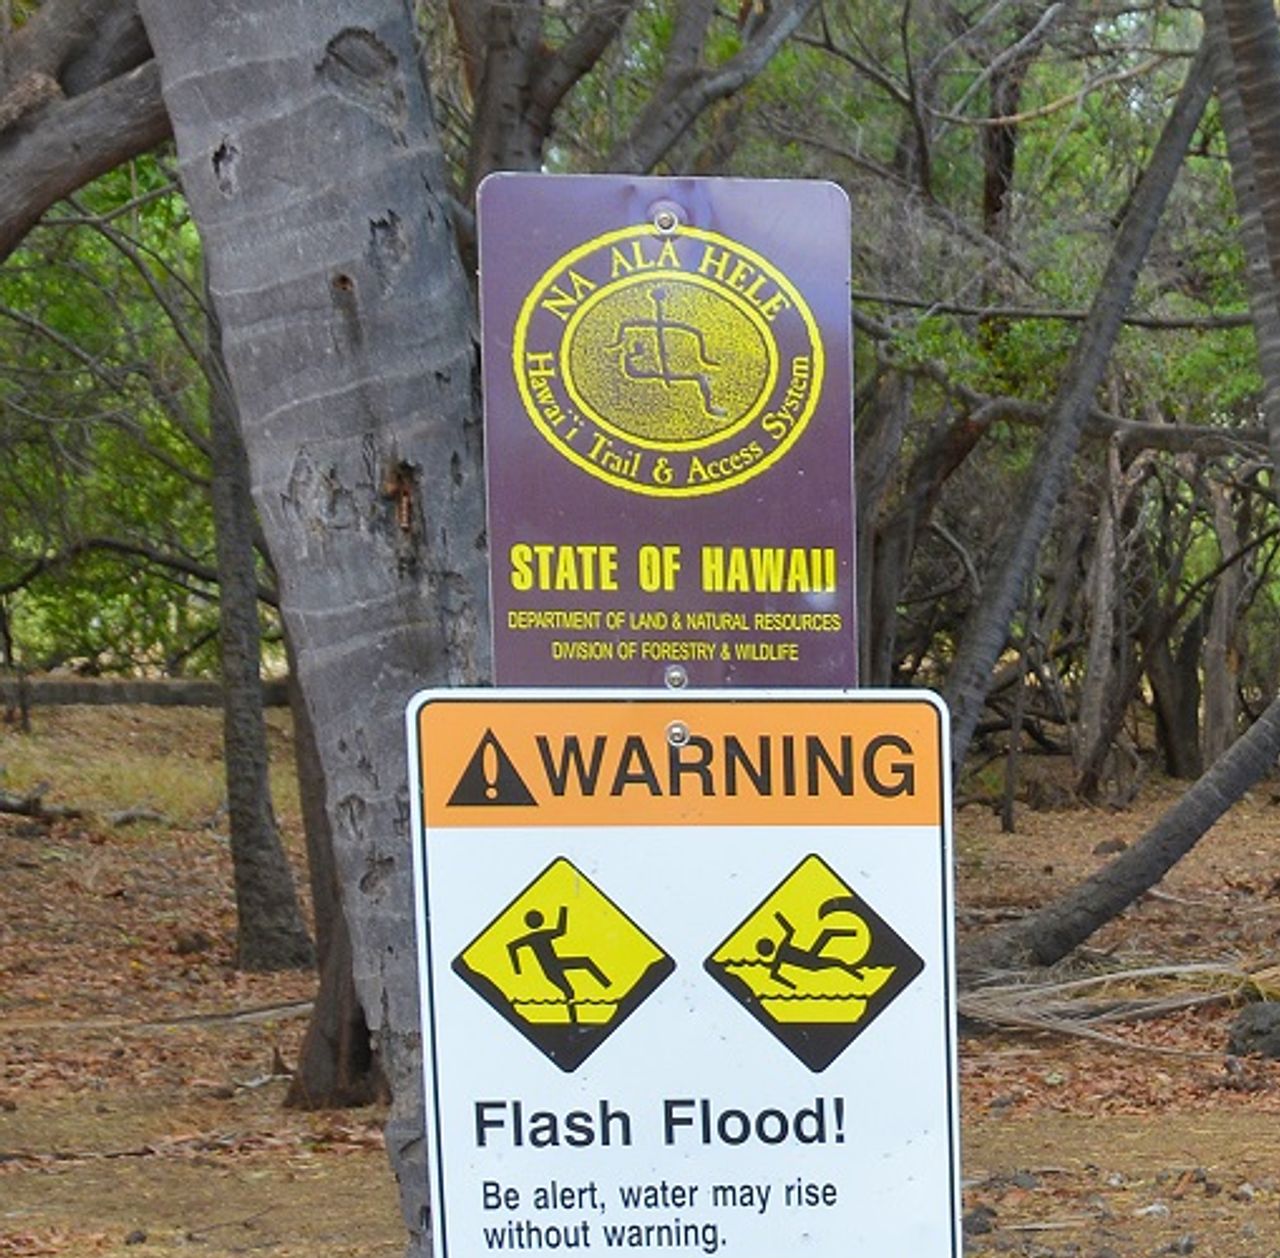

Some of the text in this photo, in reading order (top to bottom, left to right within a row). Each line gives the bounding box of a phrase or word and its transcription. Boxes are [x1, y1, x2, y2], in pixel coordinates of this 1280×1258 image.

[541, 238, 791, 320] NA ALA HELE
[588, 433, 640, 477] Trail
[652, 456, 673, 484] &
[688, 441, 764, 483] Access
[762, 356, 809, 439] System
[511, 544, 836, 591] STATE OF HAWAII
[510, 610, 841, 630] DEPARTMENT OF LAND & NATURAL RESOURCES
[554, 641, 797, 660] DIVISION OF FORESTRY & WILDLIFE
[536, 733, 914, 798] WARNING
[475, 1098, 844, 1147] Flash Flood!
[484, 1178, 836, 1214] Be alert, water may rise
[484, 1219, 725, 1254] without warning.
